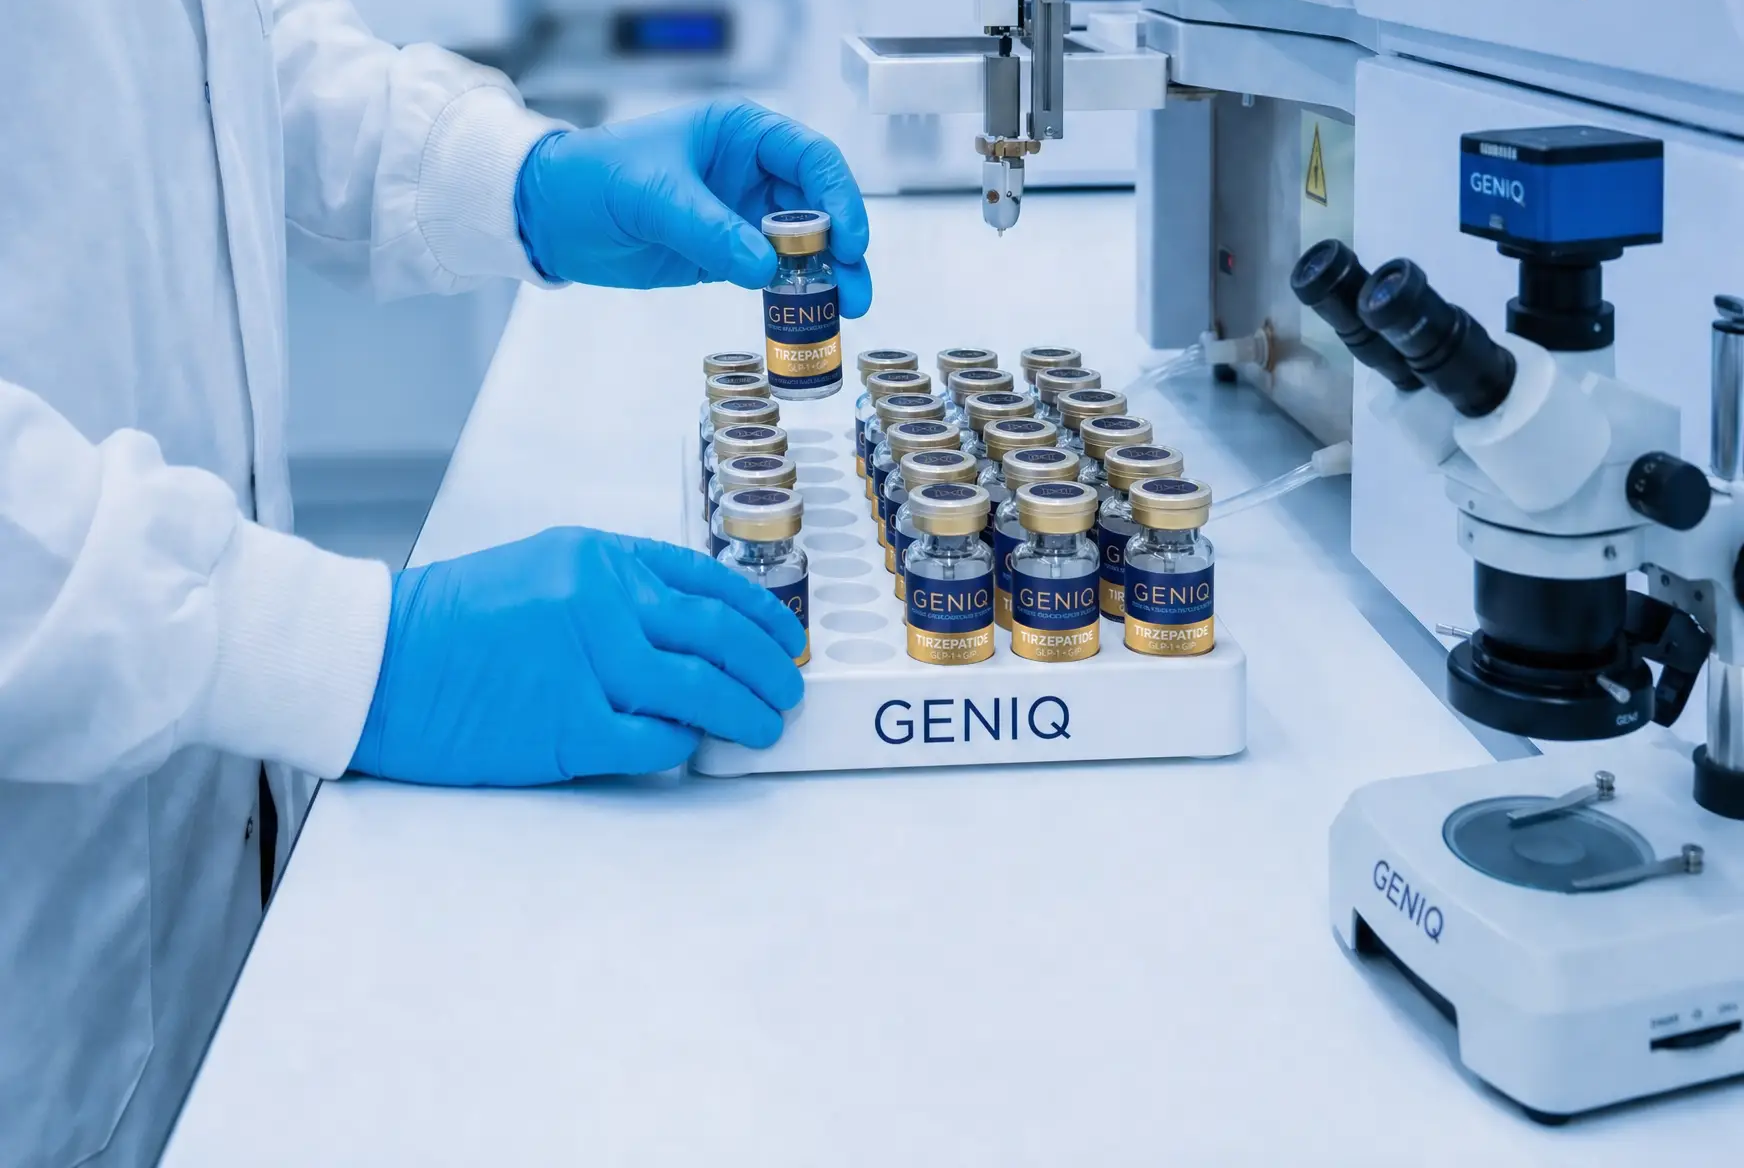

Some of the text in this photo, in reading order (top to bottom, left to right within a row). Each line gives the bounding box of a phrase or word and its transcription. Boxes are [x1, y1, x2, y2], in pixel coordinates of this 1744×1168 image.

[1470, 172, 1526, 208] GENIQ
[768, 302, 836, 325] GENIQ
[774, 342, 837, 361] TIRZEPATIDE
[913, 589, 988, 612] GENIQ
[1020, 587, 1094, 611] GENIQ
[1134, 582, 1210, 605] GENIQ
[916, 632, 989, 649] TIRZEPATIDE
[1020, 630, 1094, 647] TIRZEPATIDE
[1134, 625, 1209, 641] TIRZEPATIDE
[874, 695, 1071, 744] GENIQ
[1373, 859, 1444, 944] GENIQ
